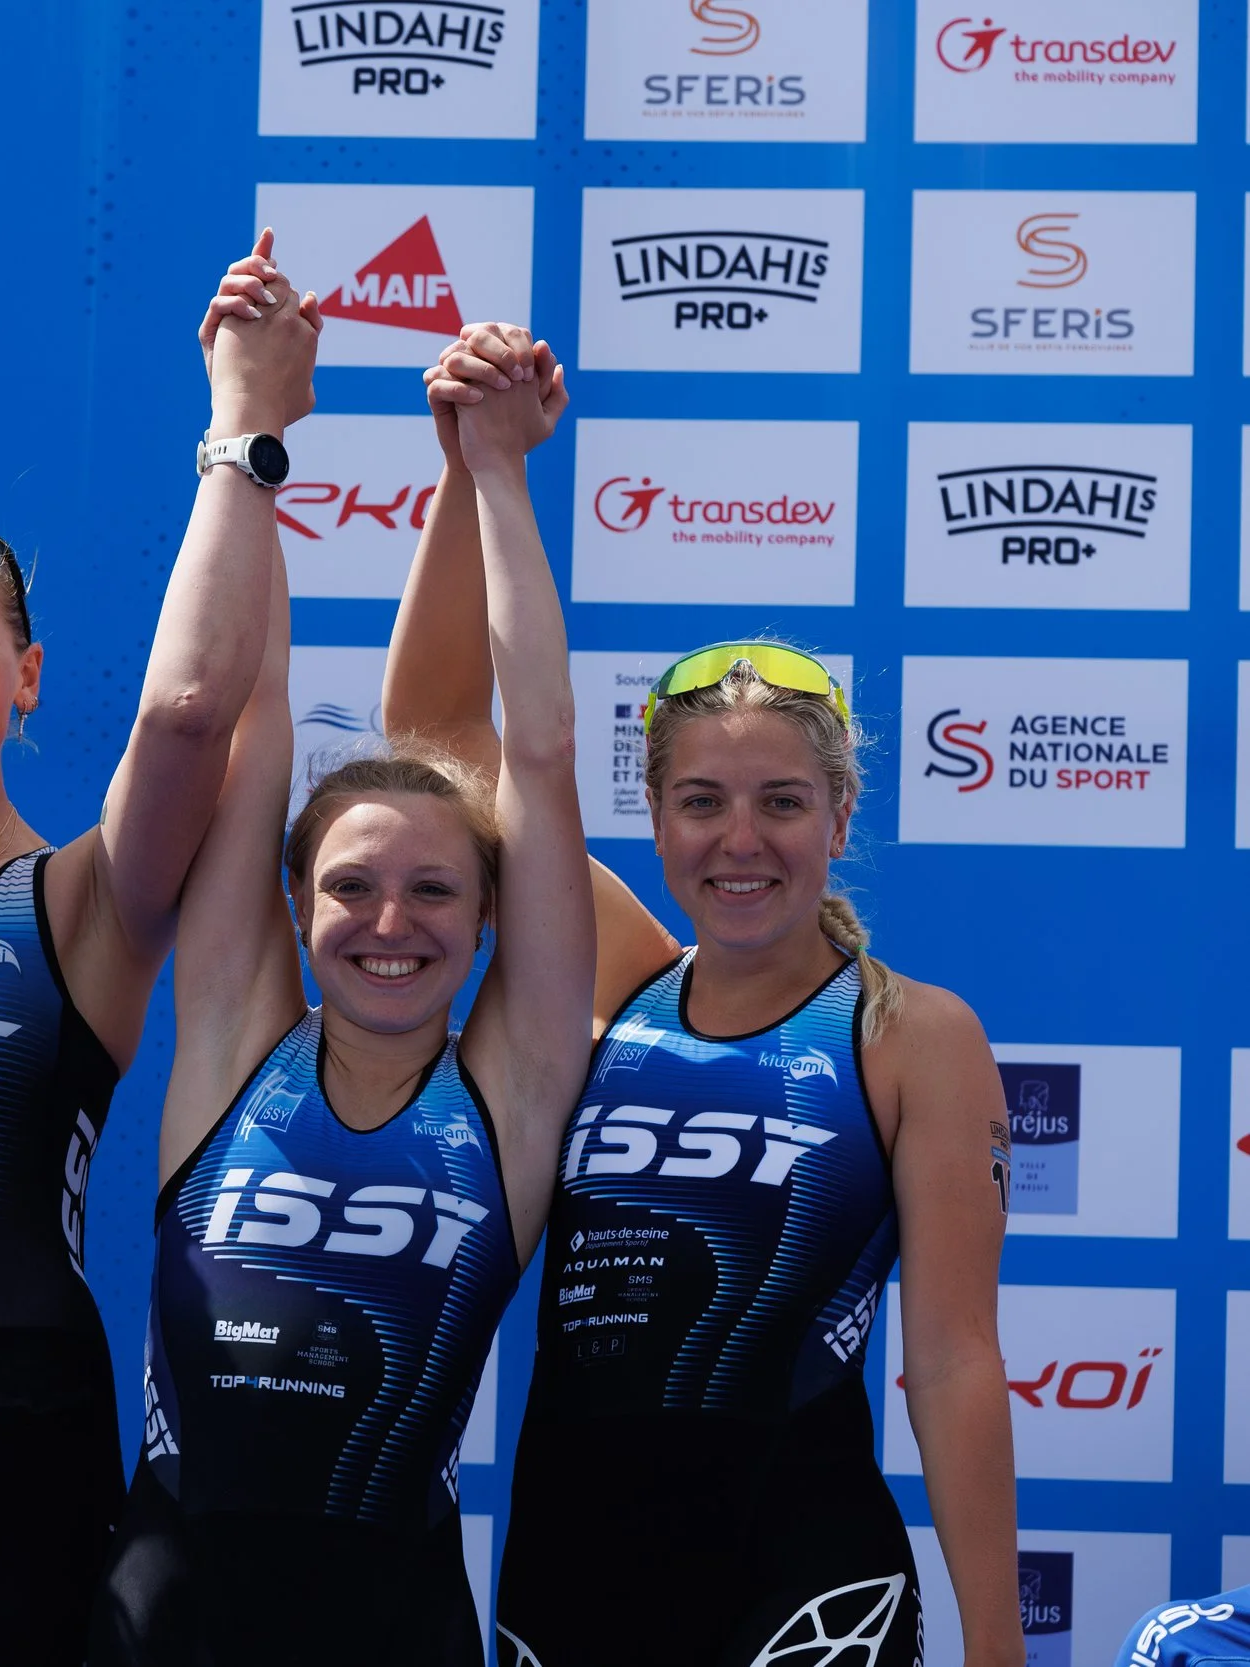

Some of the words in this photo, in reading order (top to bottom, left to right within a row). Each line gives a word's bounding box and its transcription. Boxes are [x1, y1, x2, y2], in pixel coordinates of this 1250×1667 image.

[1010, 34, 1176, 64] transdev
[354, 67, 444, 95] PRO+
[1015, 70, 1038, 83] the
[1044, 69, 1104, 86] mobility
[1109, 72, 1176, 86] company
[341, 273, 452, 308] MAIF
[675, 301, 768, 330] PRO+
[668, 494, 835, 524] transdev
[672, 531, 696, 543] the
[702, 531, 762, 547] mobility
[768, 533, 834, 547] company
[1001, 537, 1096, 565] PRO+
[1010, 716, 1126, 736] AGENCE
[1009, 742, 1168, 765] NATIONALE
[1008, 769, 1047, 789] DU
[1056, 770, 1150, 790] SPORT
[617, 1047, 646, 1061] ISSY
[758, 1051, 826, 1075] kiwami
[260, 1106, 290, 1122] ISSY
[413, 1122, 470, 1141] kiwam
[562, 1104, 839, 1187] ISSY
[203, 1168, 490, 1269] ISSY
[625, 1239, 649, 1248] Sportif
[563, 1256, 665, 1273] AQUAMAN
[628, 1275, 654, 1284] SMS
[558, 1284, 596, 1303] BigMat
[214, 1320, 280, 1344] BigMat
[317, 1324, 338, 1334] SMS
[562, 1313, 649, 1333] TOP4RUNNING
[296, 1350, 350, 1363] MANAGEMENT
[310, 1345, 339, 1355] SPORTS
[308, 1359, 336, 1368] SCHOOL
[210, 1374, 346, 1399] TOP4RUNNING
